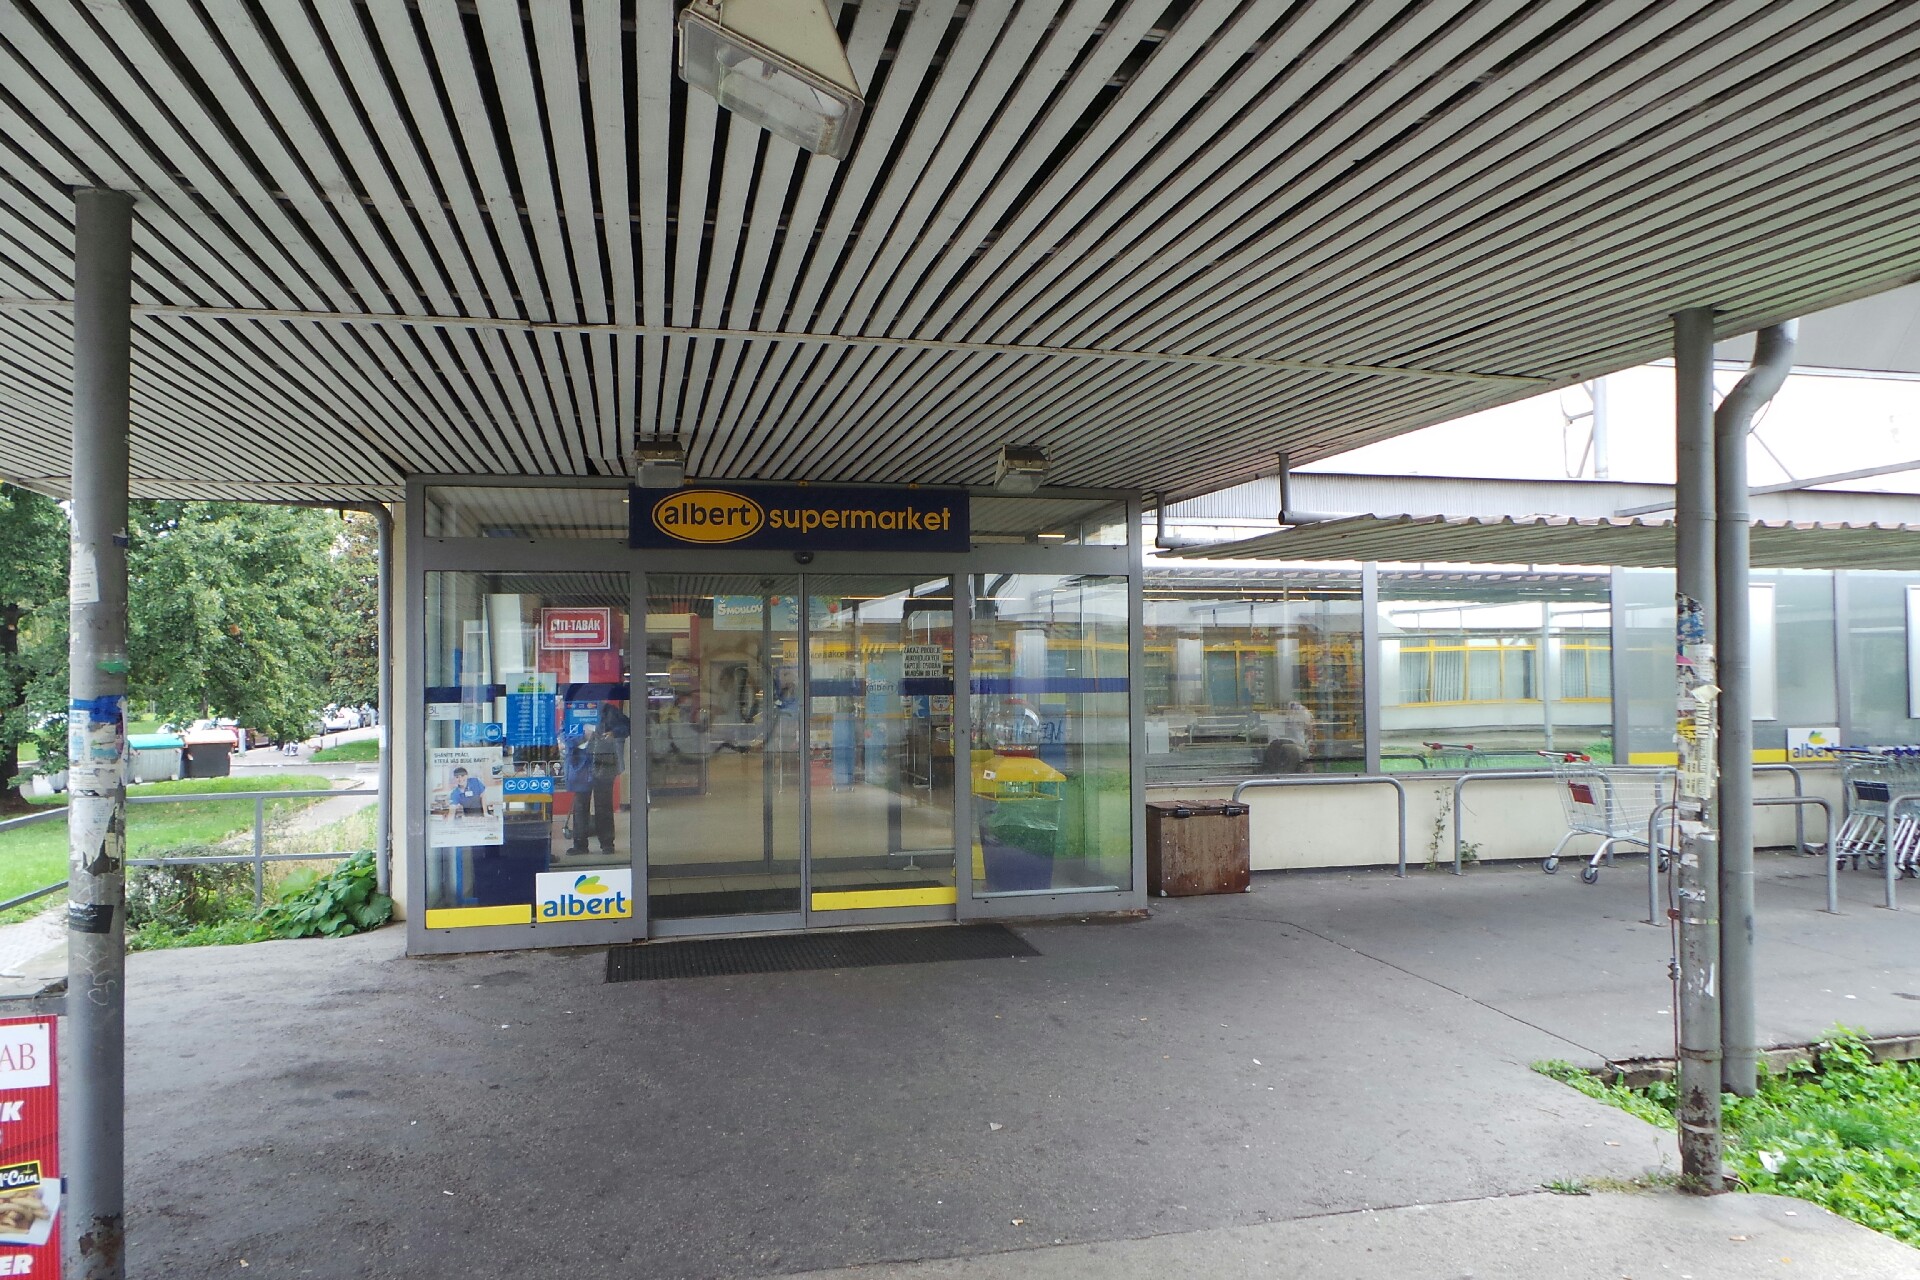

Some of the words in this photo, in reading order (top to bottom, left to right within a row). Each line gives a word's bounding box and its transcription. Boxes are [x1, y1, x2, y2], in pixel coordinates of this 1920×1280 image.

[664, 503, 750, 525] albert
[769, 507, 950, 533] supermarket
[543, 891, 626, 917] albert
[0, 1101, 25, 1122] K
